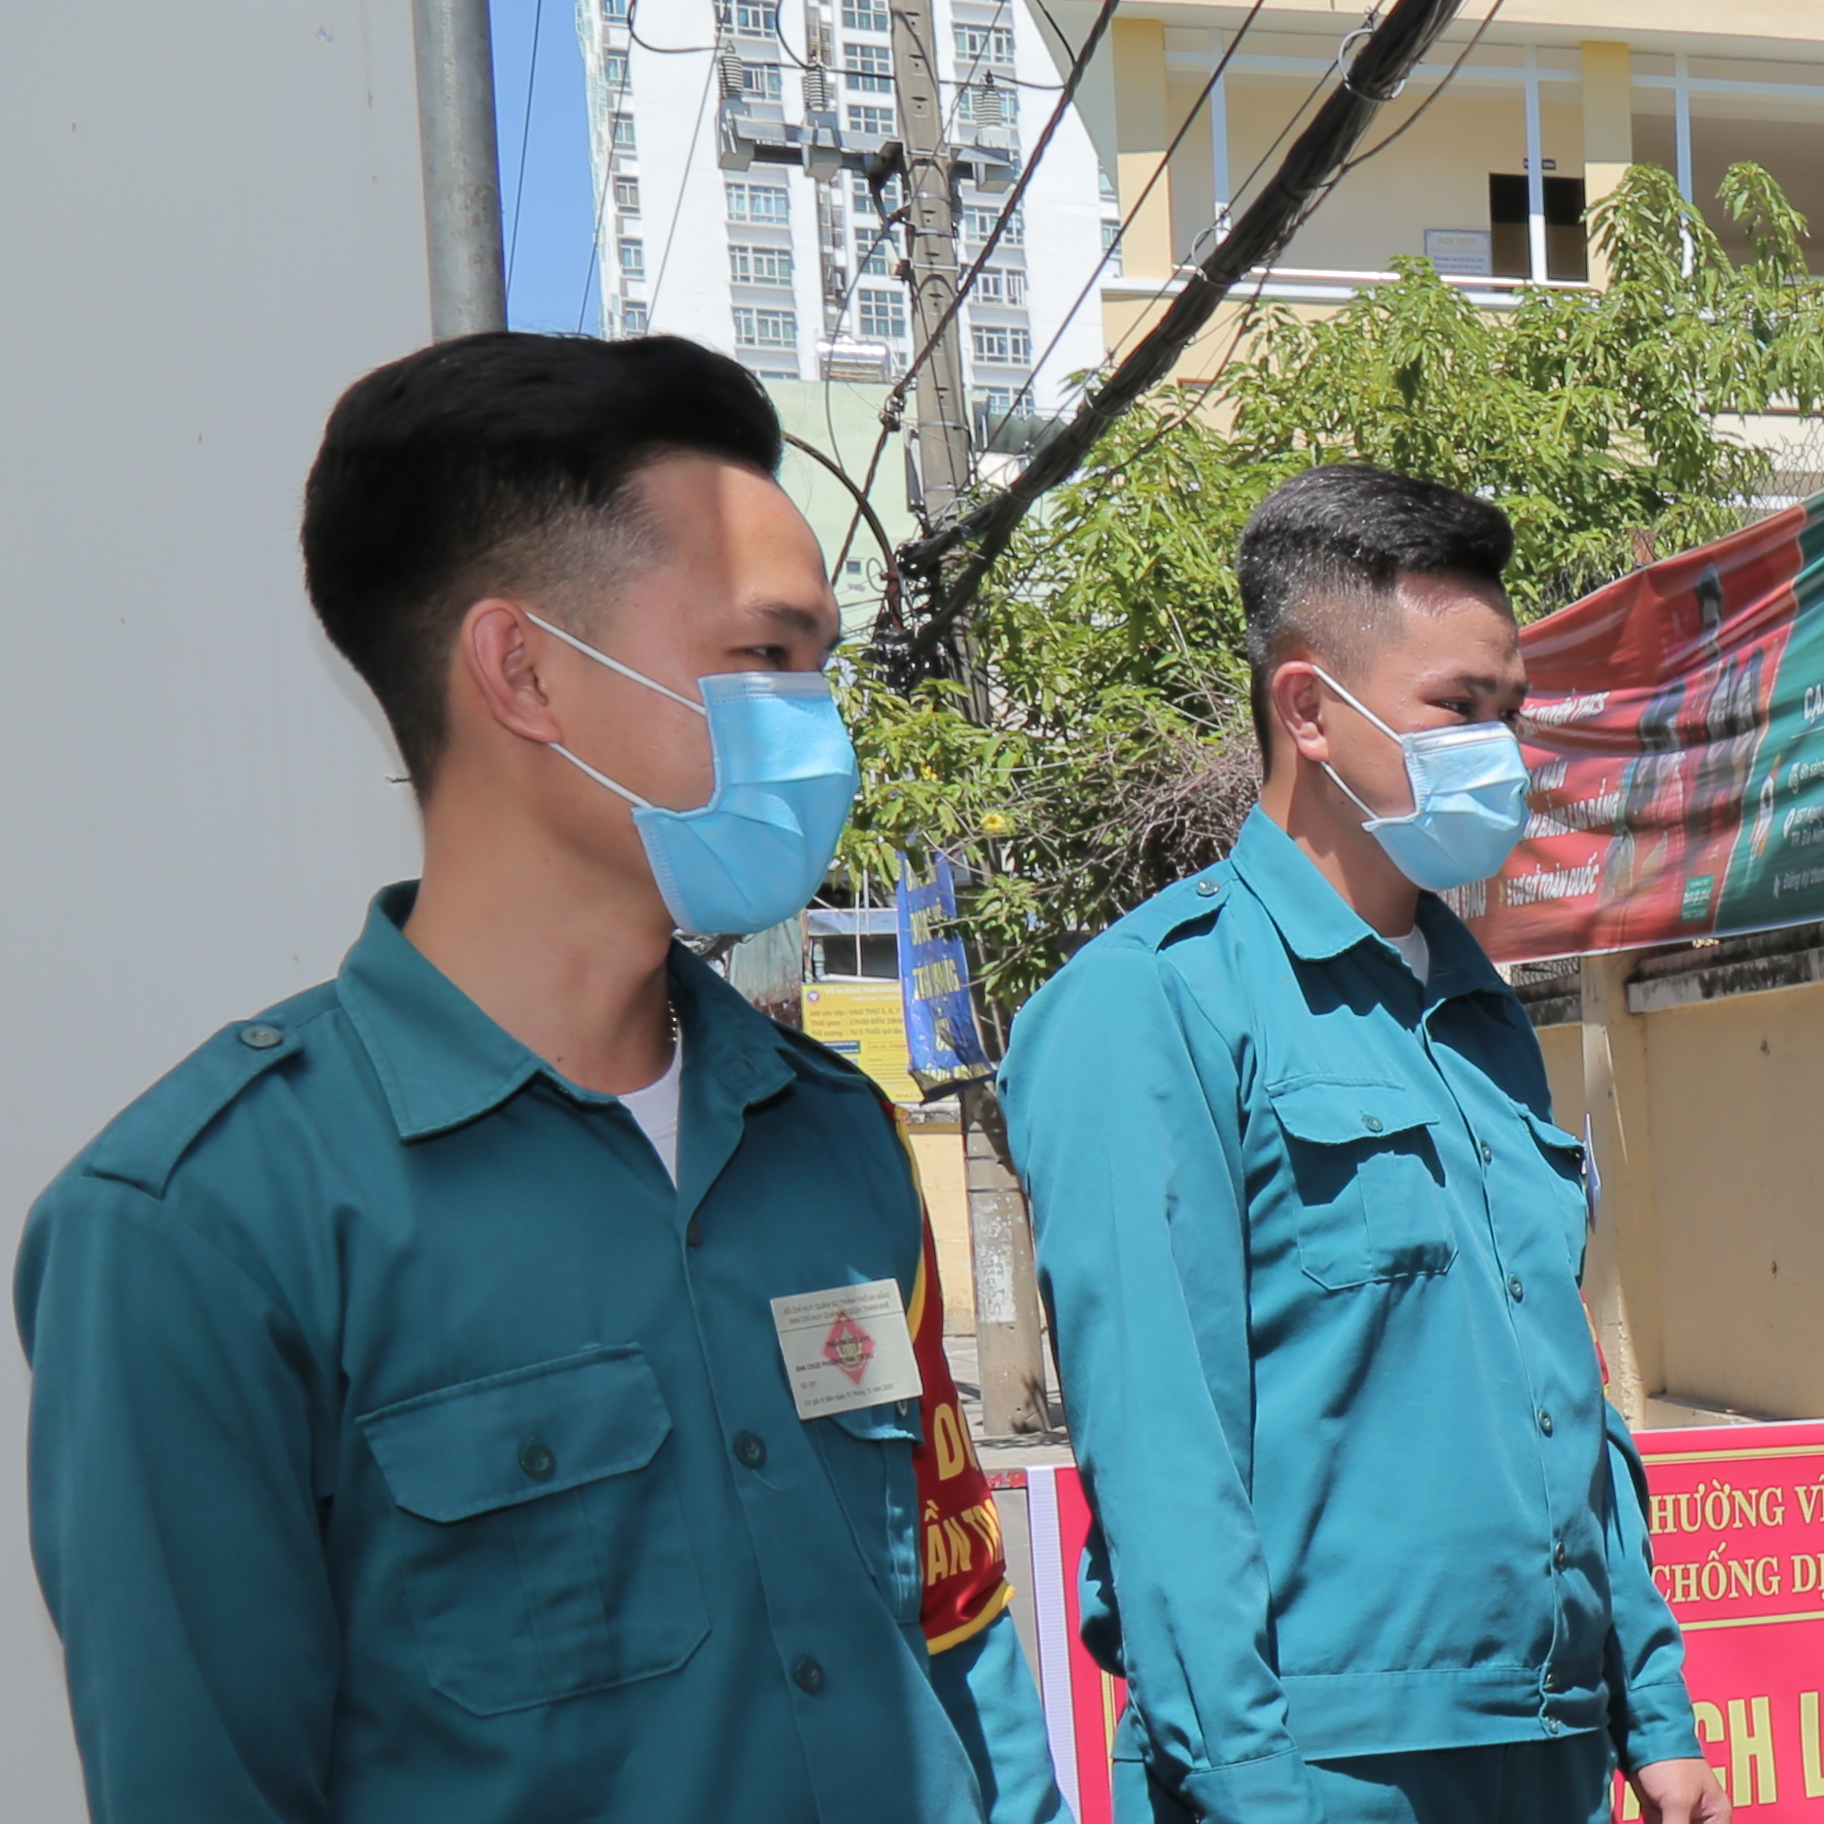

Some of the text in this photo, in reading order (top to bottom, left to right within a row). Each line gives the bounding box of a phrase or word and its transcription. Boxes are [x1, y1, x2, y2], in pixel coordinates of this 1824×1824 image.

[1537, 862, 1568, 900] TOÀN
[1566, 851, 1600, 897] QUỐC
[1649, 1478, 1785, 1534] HƯỜNG
[924, 1500, 973, 1586] ẦN
[1651, 1542, 1782, 1603] CHỐNG
